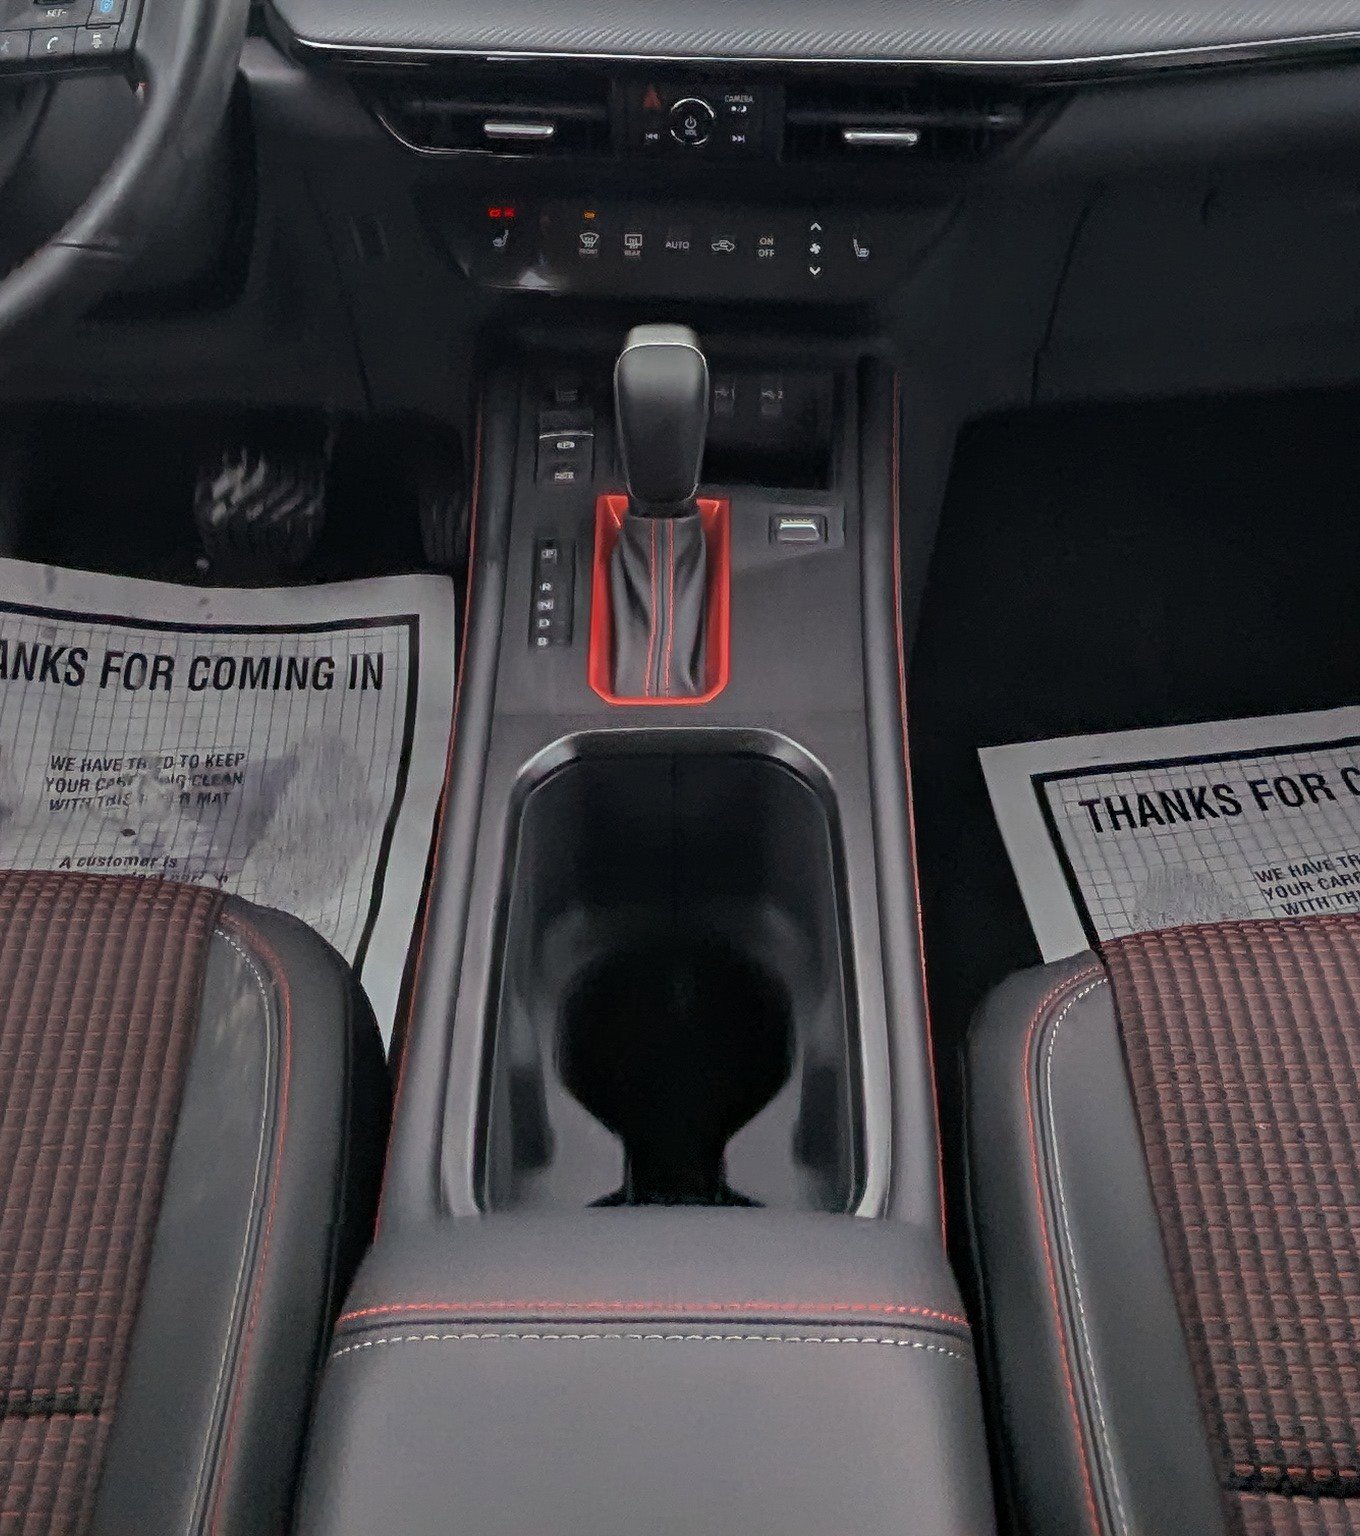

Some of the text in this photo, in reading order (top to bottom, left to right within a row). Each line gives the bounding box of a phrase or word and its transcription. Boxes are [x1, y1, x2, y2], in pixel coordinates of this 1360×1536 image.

[724, 94, 754, 103] CAMERA
[665, 240, 690, 249] AUTO
[759, 237, 774, 246] ON
[758, 249, 775, 257] OFF
[100, 651, 175, 691] FOR
[188, 654, 336, 691] COMING
[348, 651, 384, 691] IN
[50, 752, 245, 773] WE HAVE TRD TO KEEP
[46, 771, 245, 793] YOUR CLEAN
[49, 796, 95, 812] WITH
[196, 792, 232, 806] MAT
[1078, 782, 1243, 834] THANKS
[1249, 772, 1336, 812] FOR
[58, 855, 71, 869] A
[163, 854, 177, 868] is
[1254, 867, 1283, 883] WE
[1290, 858, 1333, 878] HAVE
[1261, 879, 1315, 901] YOUR
[1281, 897, 1331, 916] WITH
